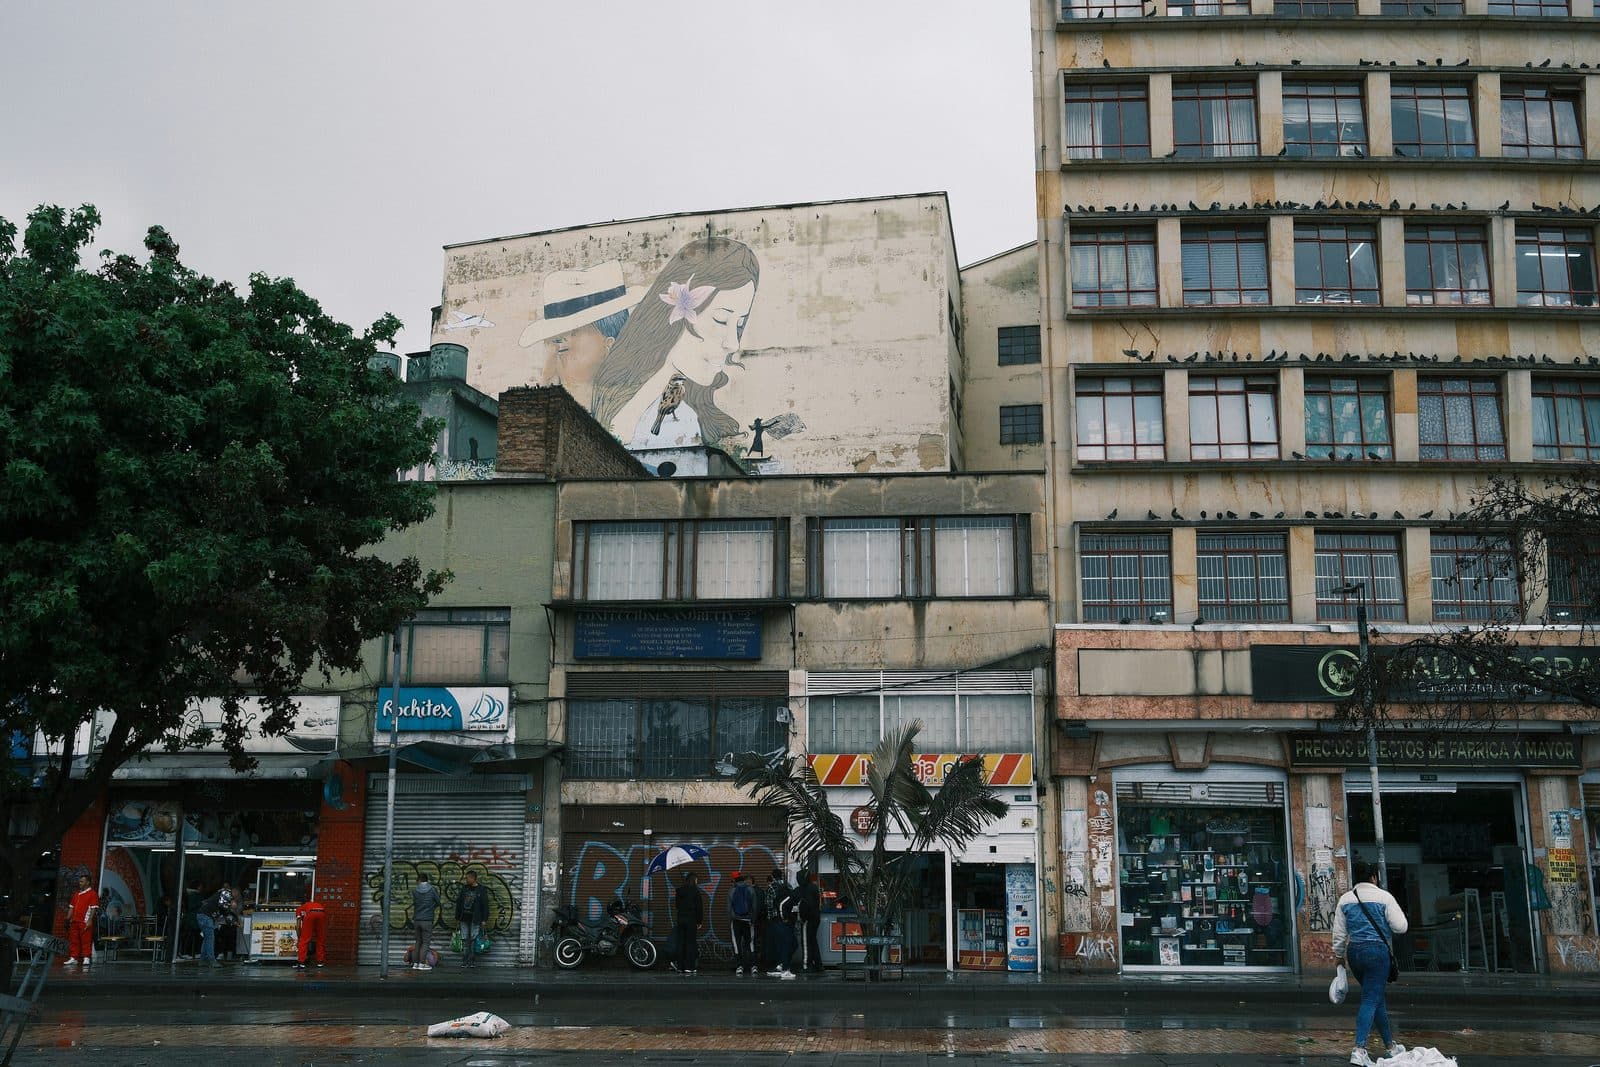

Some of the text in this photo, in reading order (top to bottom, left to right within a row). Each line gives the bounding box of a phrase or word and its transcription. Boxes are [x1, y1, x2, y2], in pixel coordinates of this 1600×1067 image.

[382, 698, 453, 718] Rochitex
[1295, 739, 1354, 758] PRECOS
[1512, 741, 1522, 760] X
[1525, 741, 1575, 760] MAYOR
